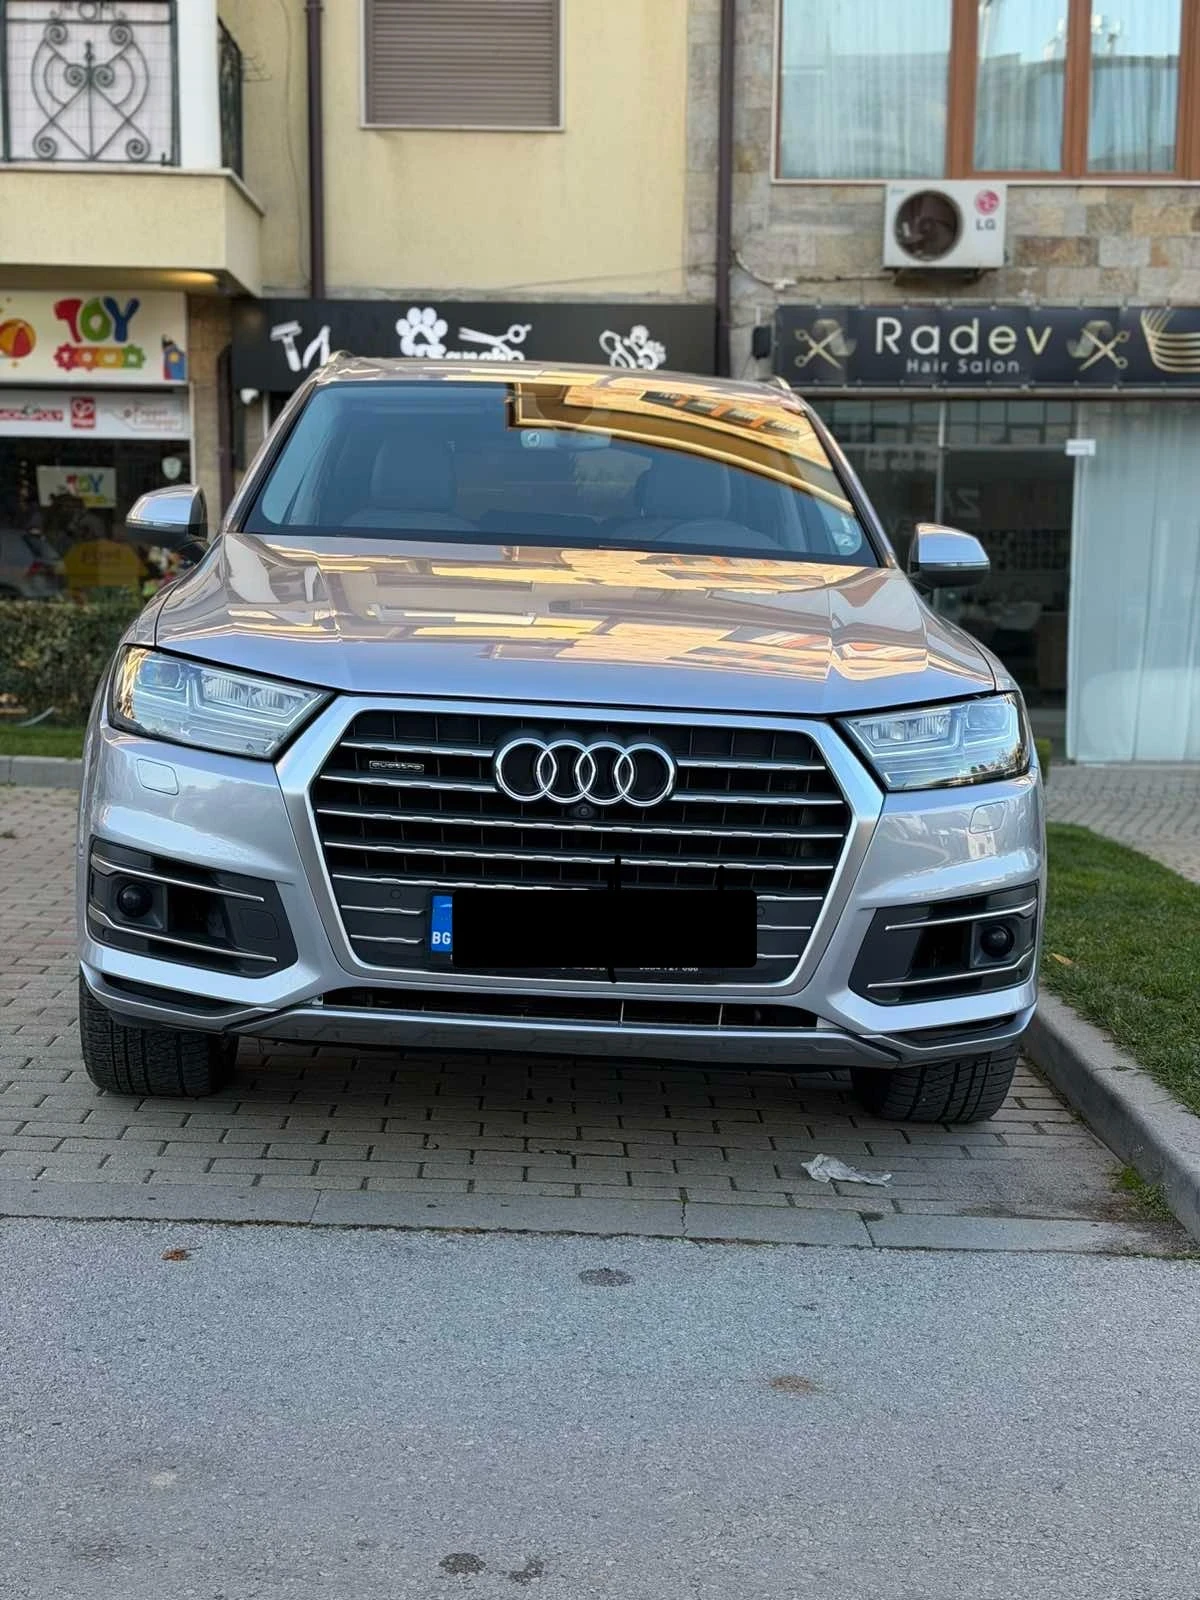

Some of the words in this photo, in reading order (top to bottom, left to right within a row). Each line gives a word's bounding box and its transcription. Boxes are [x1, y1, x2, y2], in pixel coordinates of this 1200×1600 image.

[975, 218, 997, 231] LG
[54, 297, 140, 343] TOY
[875, 316, 1052, 355] Radev
[906, 358, 949, 374] Hair
[957, 358, 1020, 374] Salon
[65, 472, 105, 496] TOY
[431, 931, 452, 945] BG
